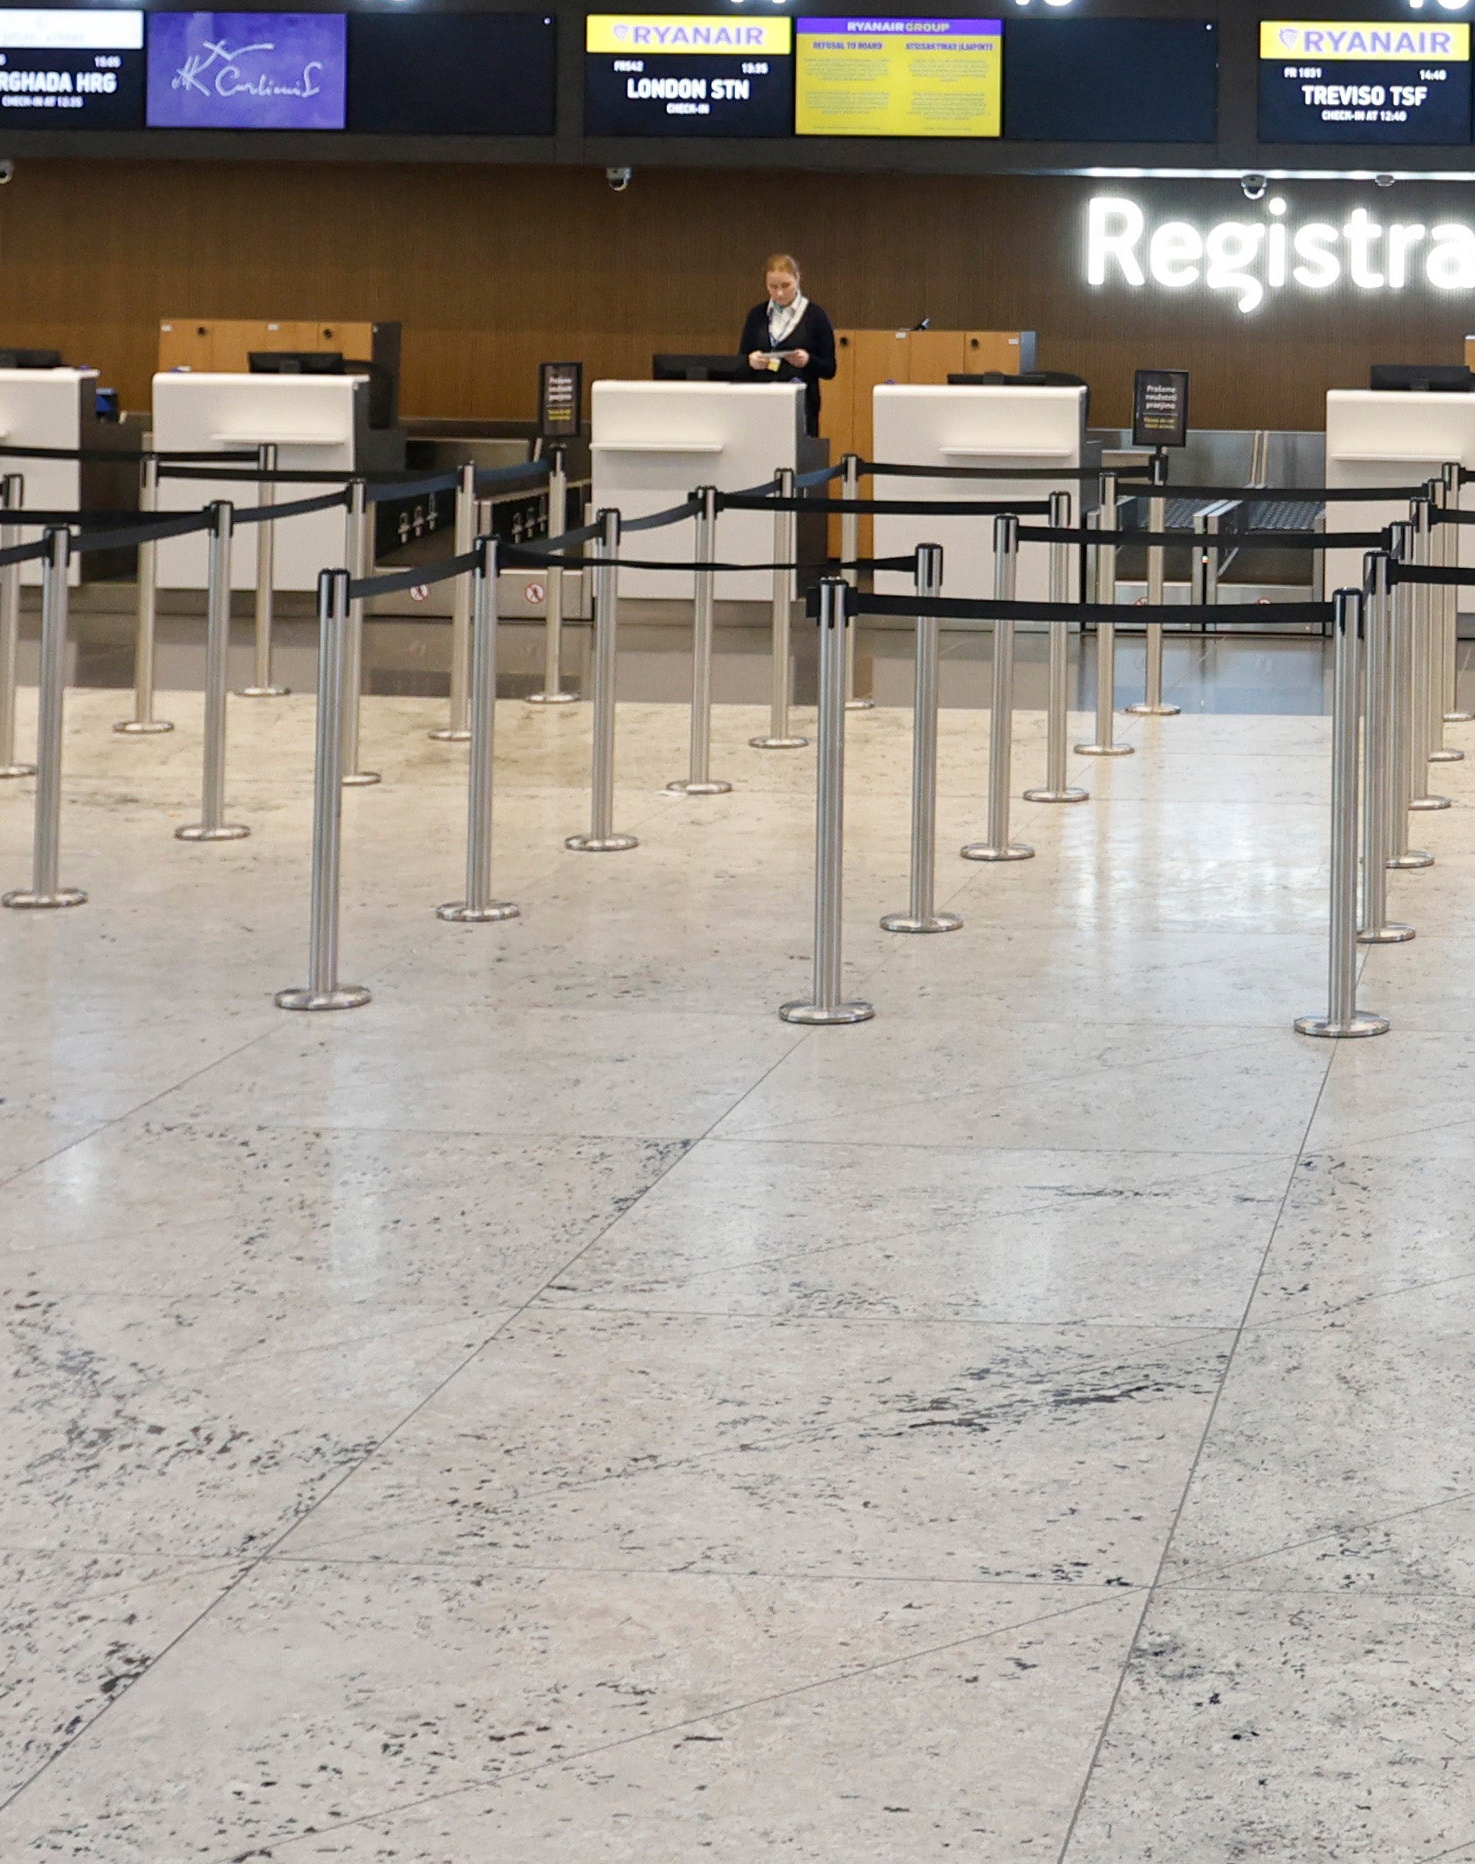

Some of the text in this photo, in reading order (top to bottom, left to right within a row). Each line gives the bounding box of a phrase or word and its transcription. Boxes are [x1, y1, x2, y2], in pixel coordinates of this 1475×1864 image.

[632, 25, 764, 46] RYANAIR
[846, 21, 950, 34] RYANAIR GROUP
[1303, 30, 1452, 54] RYANAIR
[76, 72, 117, 93] HRG
[627, 78, 750, 100] LONDON STN
[1301, 85, 1428, 107] TREVISO TSF
[1321, 109, 1408, 122] CHECK-IN AT 12:40
